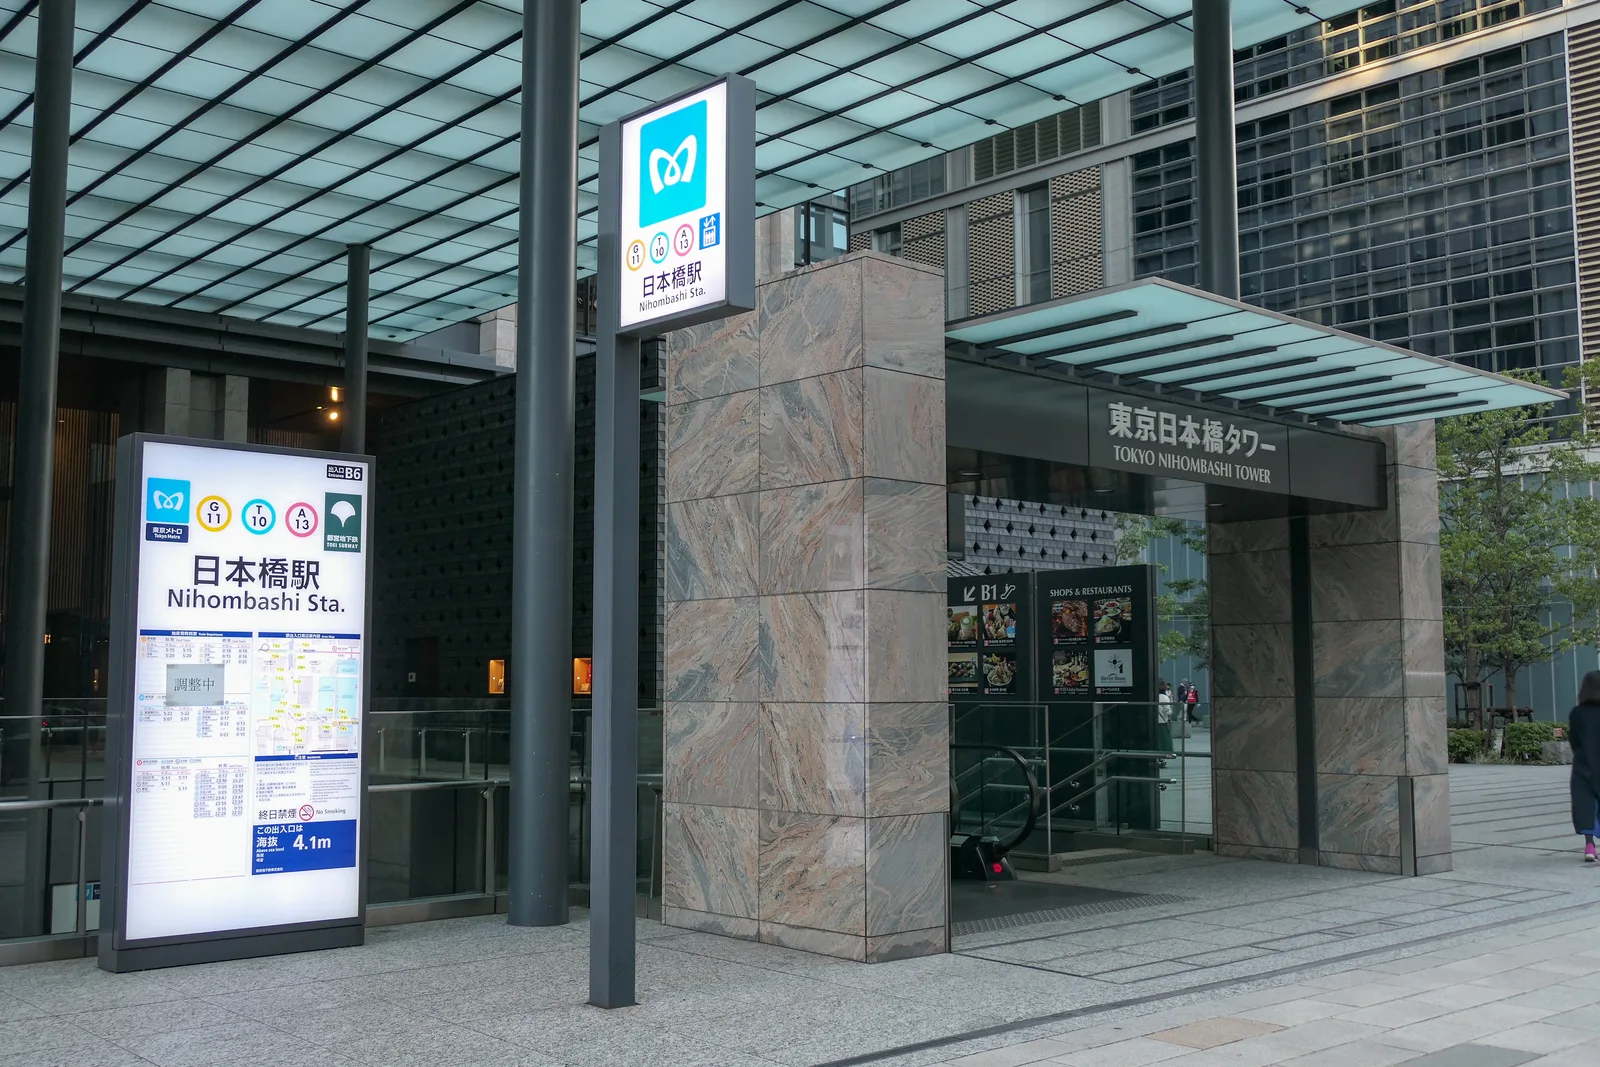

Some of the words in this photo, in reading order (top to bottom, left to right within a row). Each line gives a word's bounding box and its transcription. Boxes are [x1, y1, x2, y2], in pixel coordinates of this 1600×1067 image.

[681, 230, 687, 238] A
[658, 237, 662, 246] T
[680, 239, 689, 250] 13
[633, 245, 639, 253] G
[655, 247, 664, 257] 10
[632, 255, 640, 264] 11
[643, 261, 702, 298] 日本橋駅
[639, 289, 687, 312] Nihombashi
[690, 287, 706, 298] Sta.
[1108, 402, 1276, 457] 東京日本橋タワー
[1114, 445, 1155, 466] TOKYO
[1158, 452, 1232, 478] NIHOMBASHI
[1235, 464, 1271, 484] TOWER
[345, 467, 361, 480] B6
[209, 502, 219, 511] G
[256, 506, 262, 514] T
[207, 513, 221, 524] 11
[298, 509, 306, 518] A
[252, 516, 267, 527] 10
[295, 519, 309, 530] 13
[327, 534, 358, 543] 都営地下鉄
[194, 555, 320, 590] 日本橋駅
[981, 584, 997, 601] B1
[1050, 588, 1072, 597] SHOPS
[1082, 585, 1132, 595] RESTAURANTS
[168, 589, 300, 611] Nihombashi
[308, 594, 345, 612] Sta.
[174, 678, 215, 692] 調整中
[258, 809, 297, 820] 終日禁煙
[257, 824, 303, 834] この出入口は
[256, 836, 278, 847] 海抜
[293, 835, 331, 850] 4.1m
